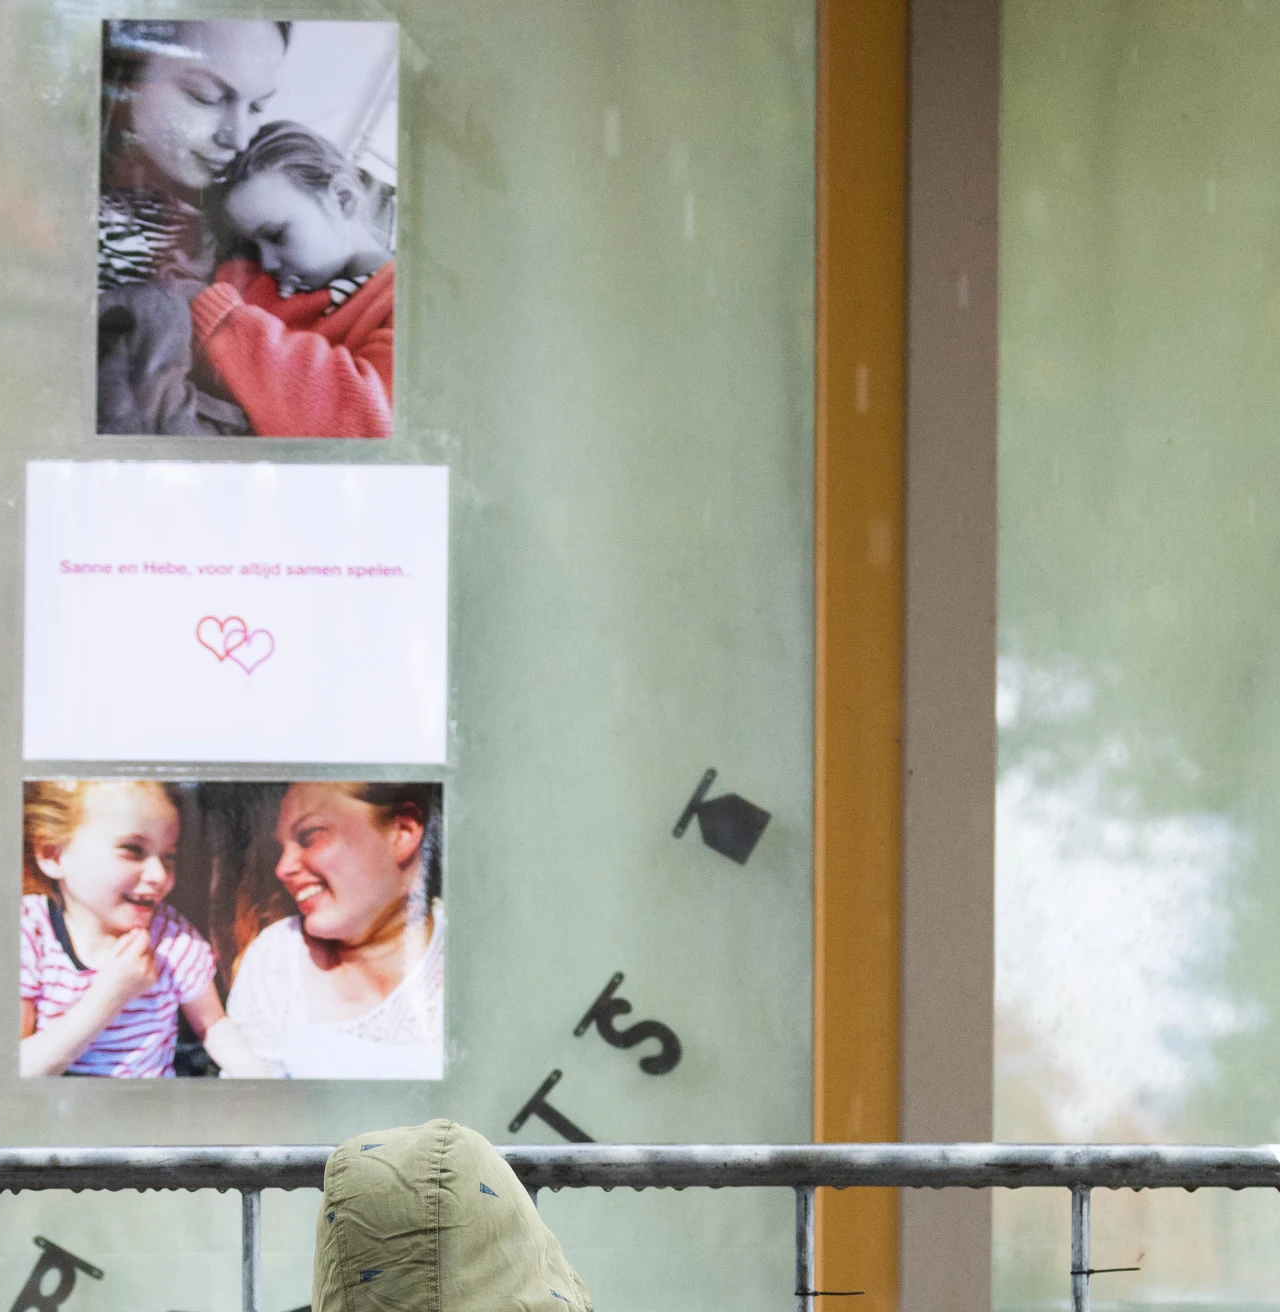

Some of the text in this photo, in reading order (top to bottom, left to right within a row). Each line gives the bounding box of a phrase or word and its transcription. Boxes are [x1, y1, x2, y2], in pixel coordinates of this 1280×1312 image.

[60, 560, 112, 574] Sanne
[118, 563, 138, 574] en
[197, 564, 234, 575] voor
[239, 562, 281, 578] altijd
[286, 564, 342, 576] samen
